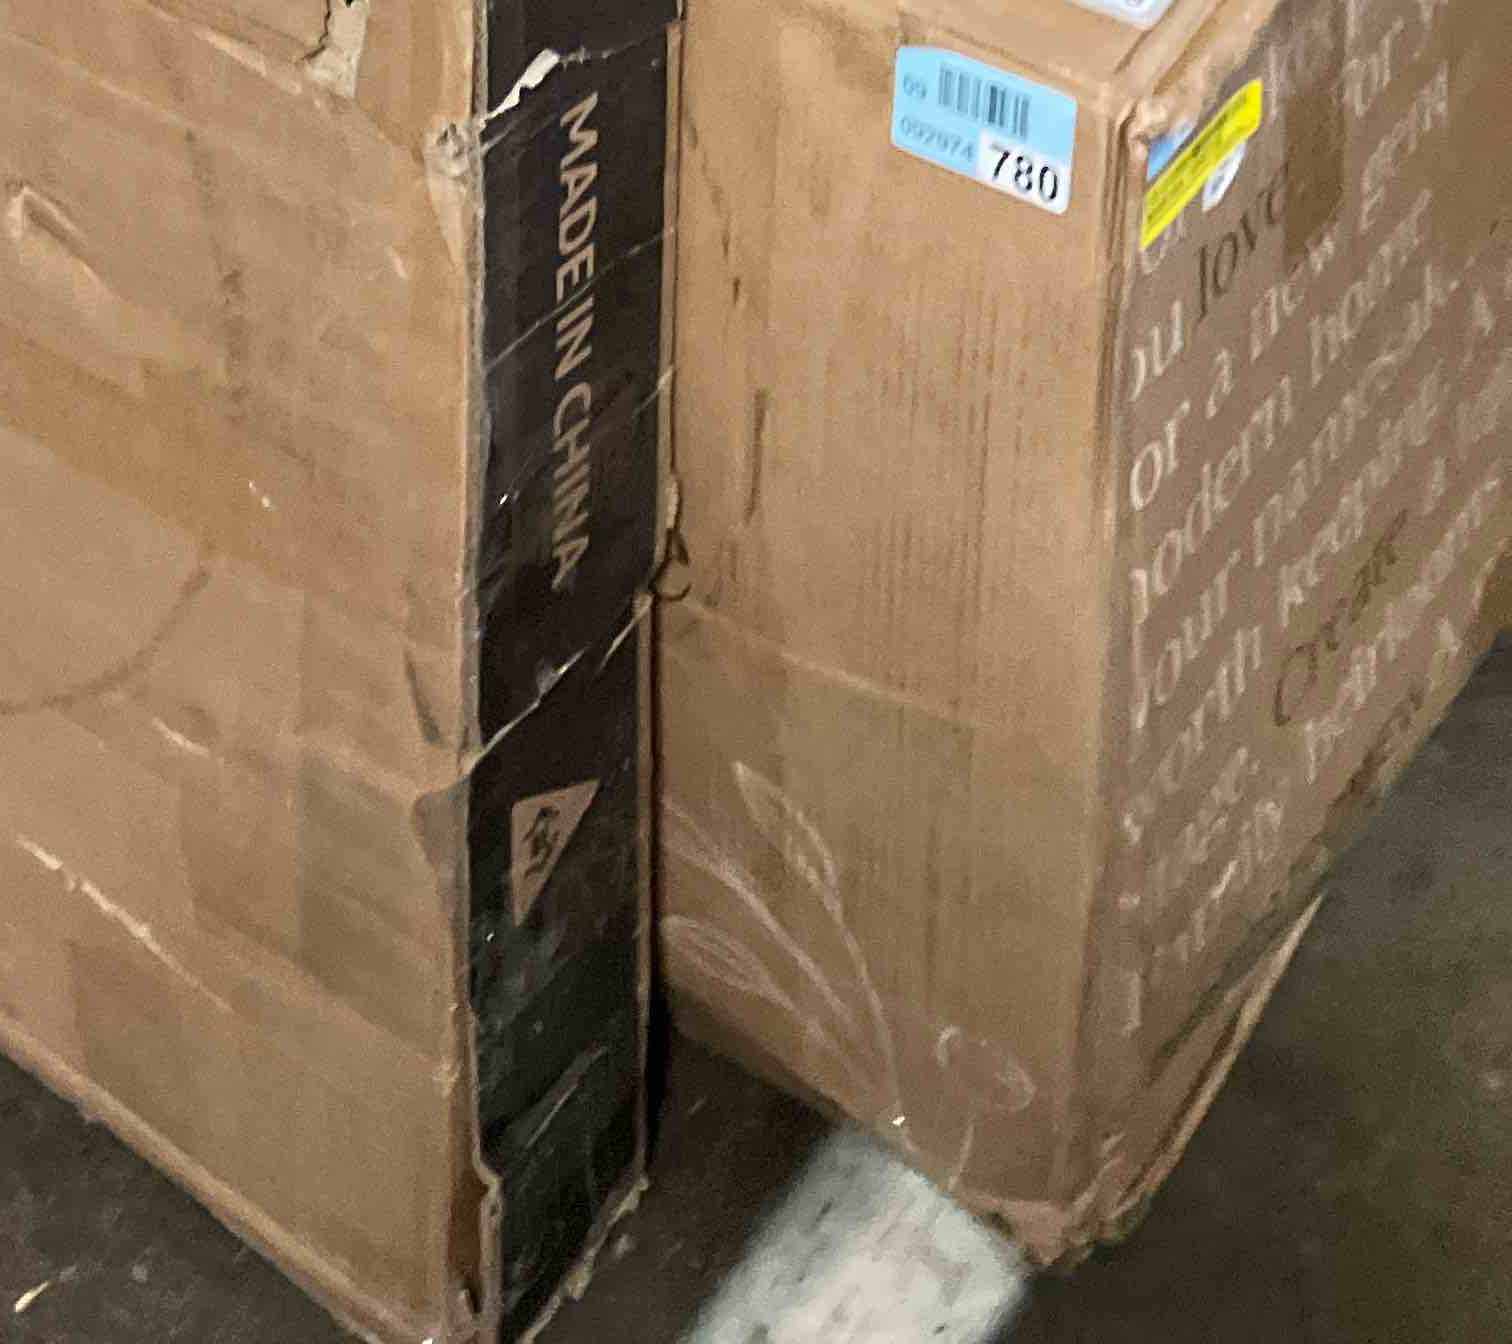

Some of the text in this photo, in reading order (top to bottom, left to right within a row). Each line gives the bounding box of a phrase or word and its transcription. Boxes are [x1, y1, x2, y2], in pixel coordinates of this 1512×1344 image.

[991, 139, 1059, 203] 780
[551, 91, 599, 593] MADE IN CHINA
